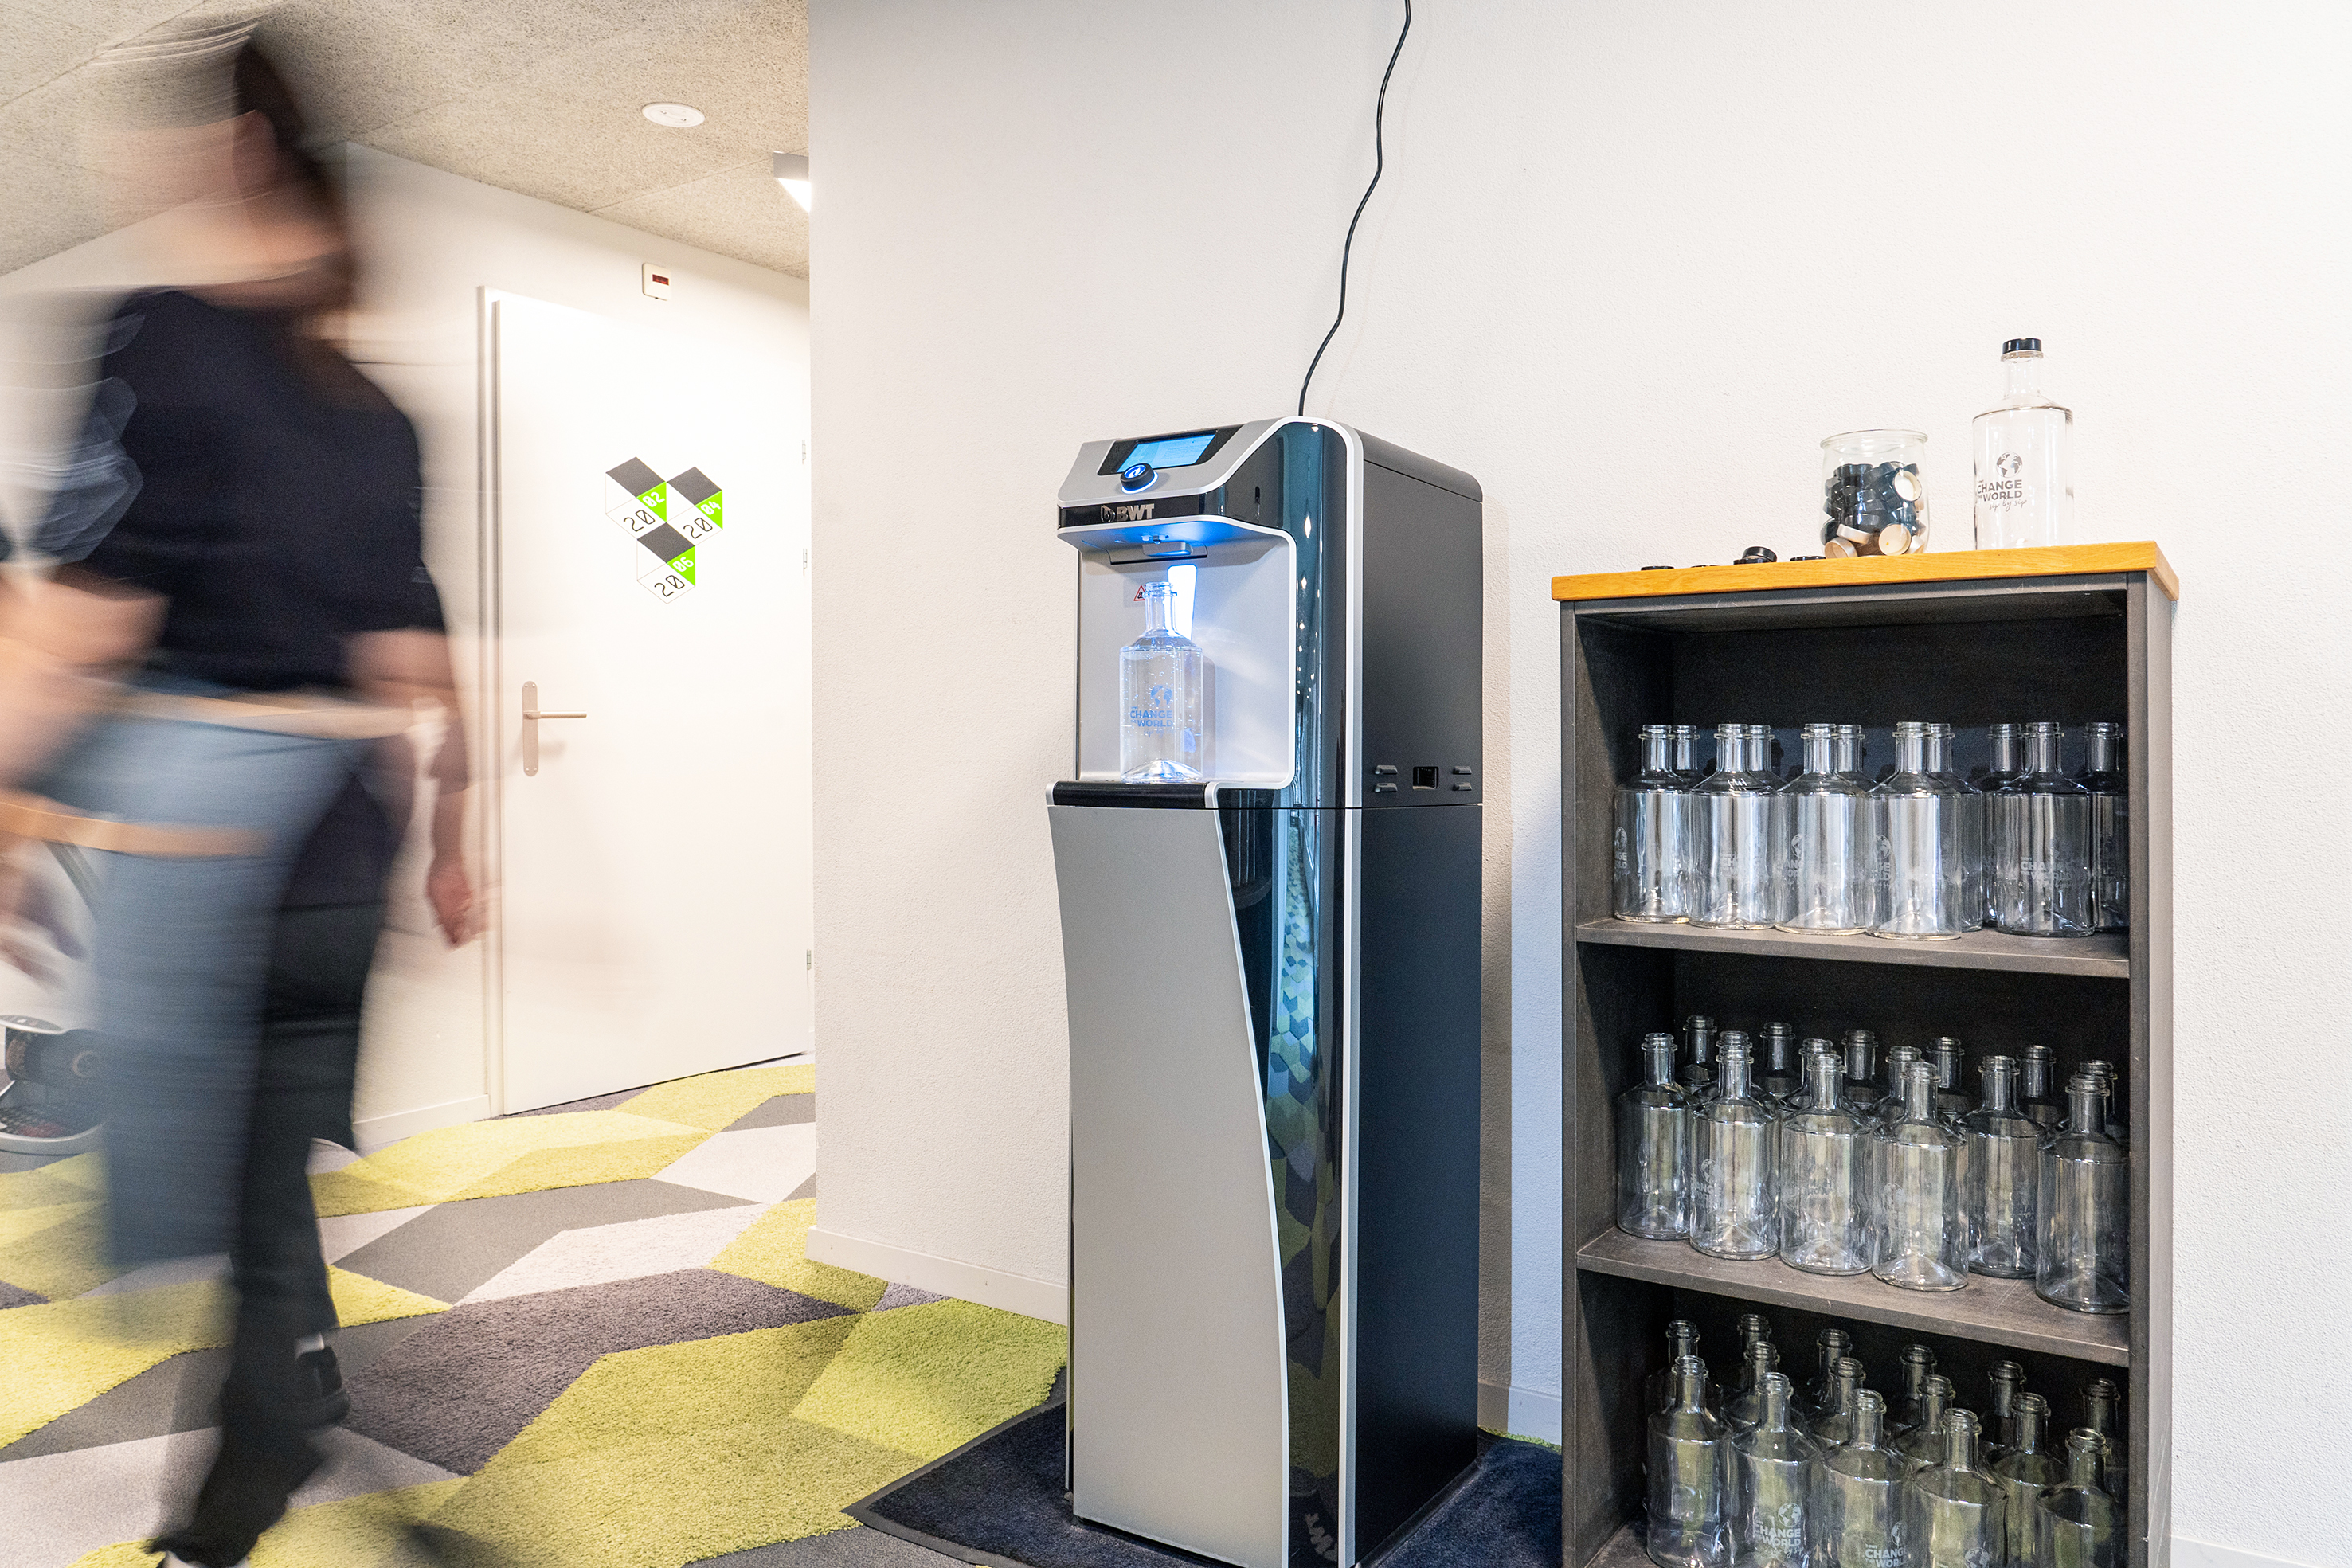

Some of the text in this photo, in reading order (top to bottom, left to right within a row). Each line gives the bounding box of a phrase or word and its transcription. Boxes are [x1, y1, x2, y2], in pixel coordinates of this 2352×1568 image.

[1977, 479, 2022, 494] CHANGE
[1982, 490, 2023, 502] WORLD
[623, 491, 665, 532] 20 02
[1117, 503, 1155, 522] BWT
[683, 501, 722, 539] 20 04
[654, 557, 694, 597] 20 06
[1130, 710, 1173, 718] CHANGE
[1762, 1535, 1802, 1546] WORLD
[1865, 1547, 1905, 1558] CHANG
[1876, 1558, 1909, 1567] WORL
